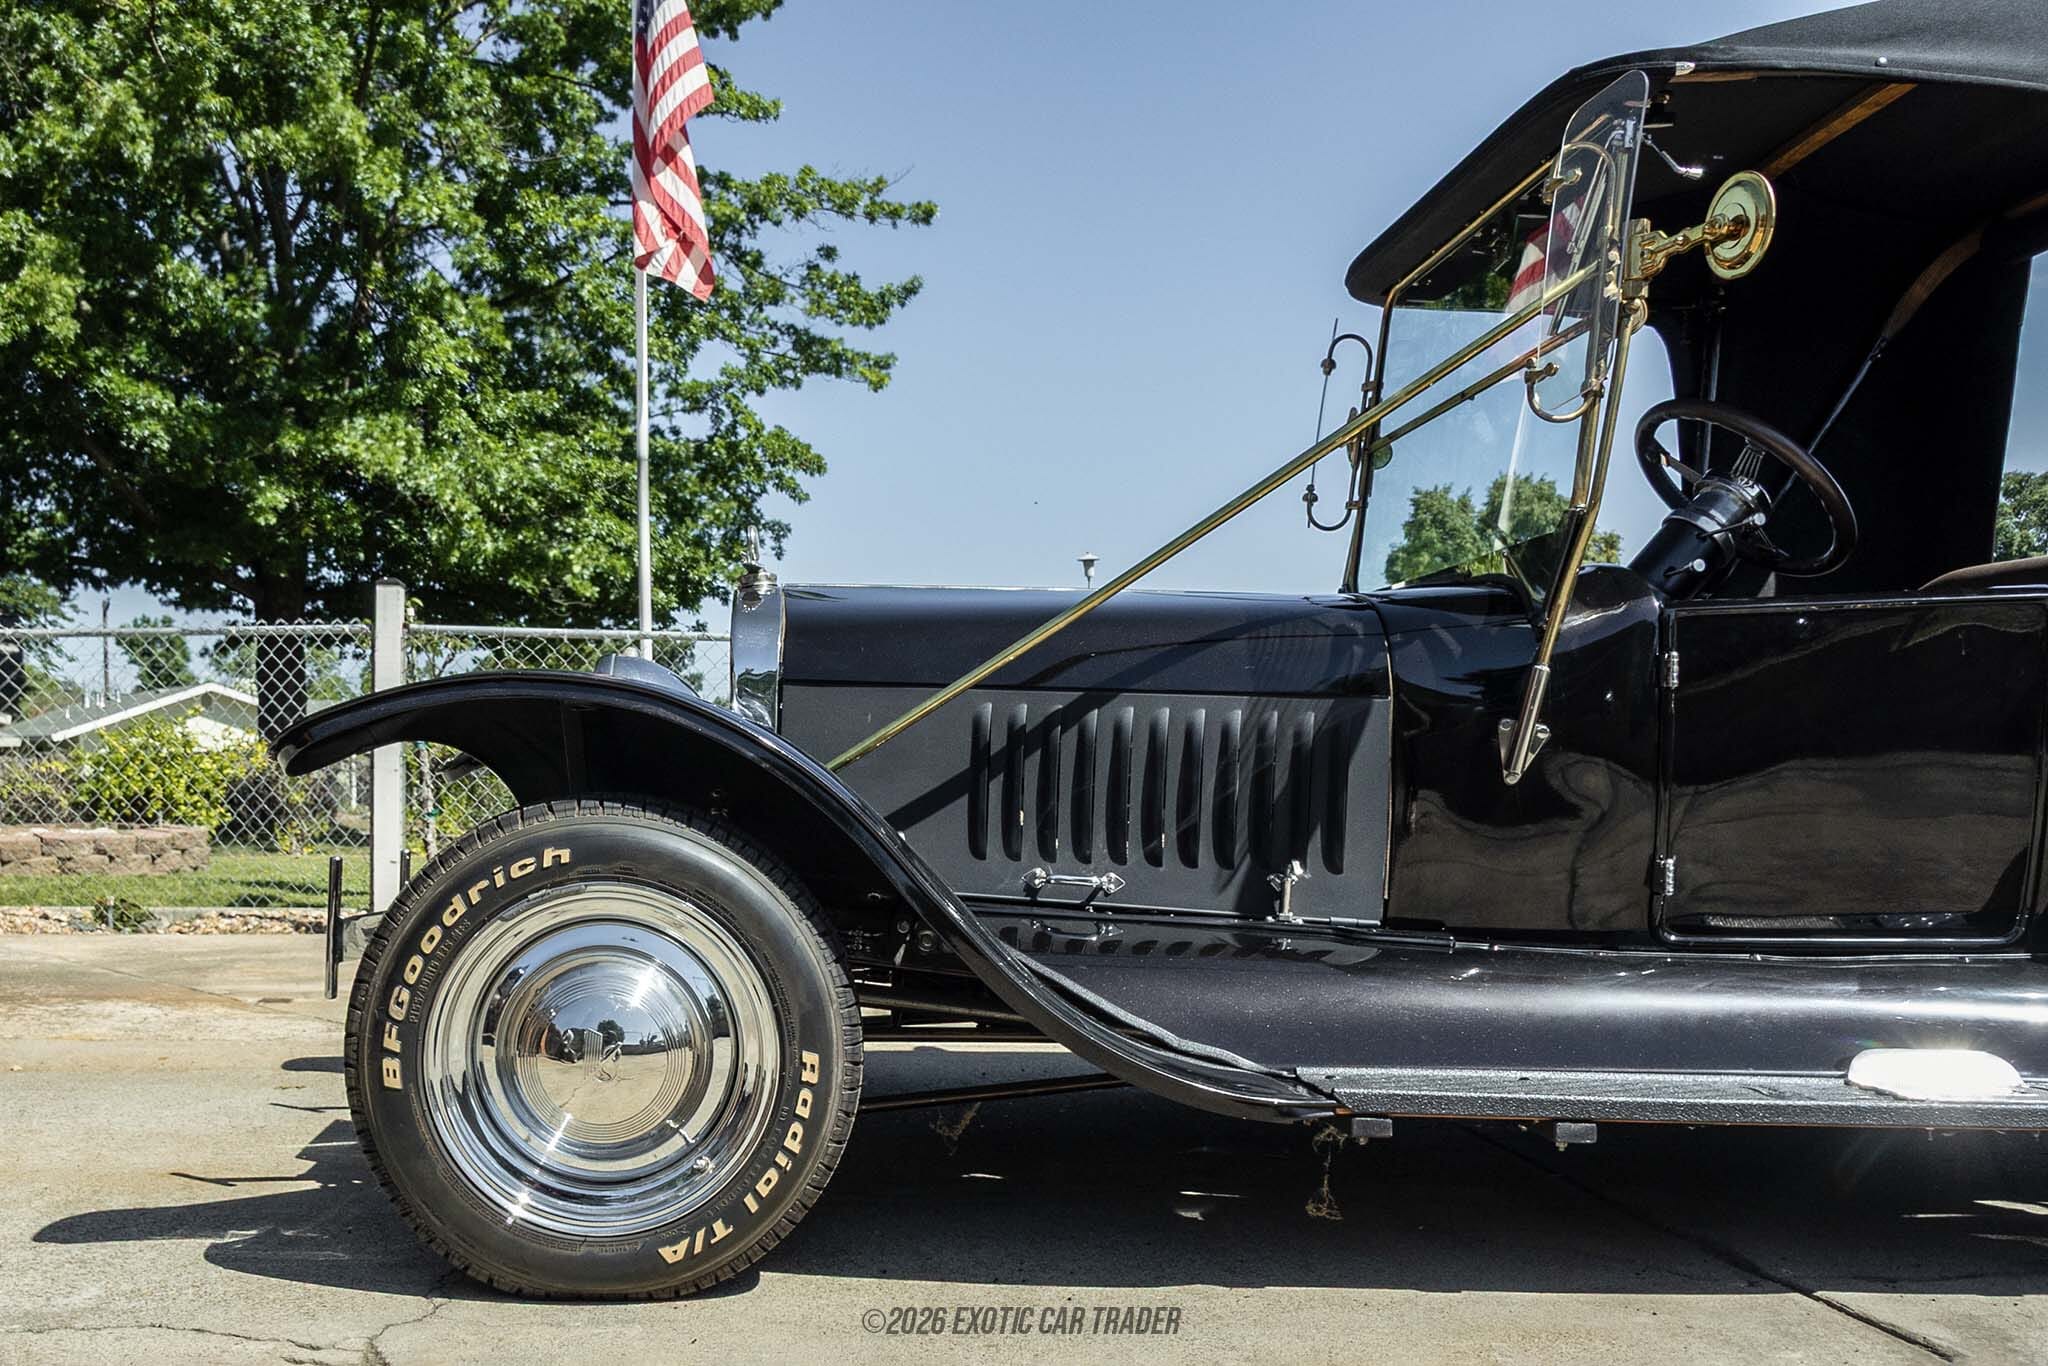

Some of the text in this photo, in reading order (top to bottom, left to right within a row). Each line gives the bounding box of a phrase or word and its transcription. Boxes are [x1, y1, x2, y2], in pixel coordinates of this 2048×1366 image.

[383, 846, 571, 1090] BFGoodrich
[744, 1051, 820, 1213] Radial
[658, 1217, 733, 1264] T/A
